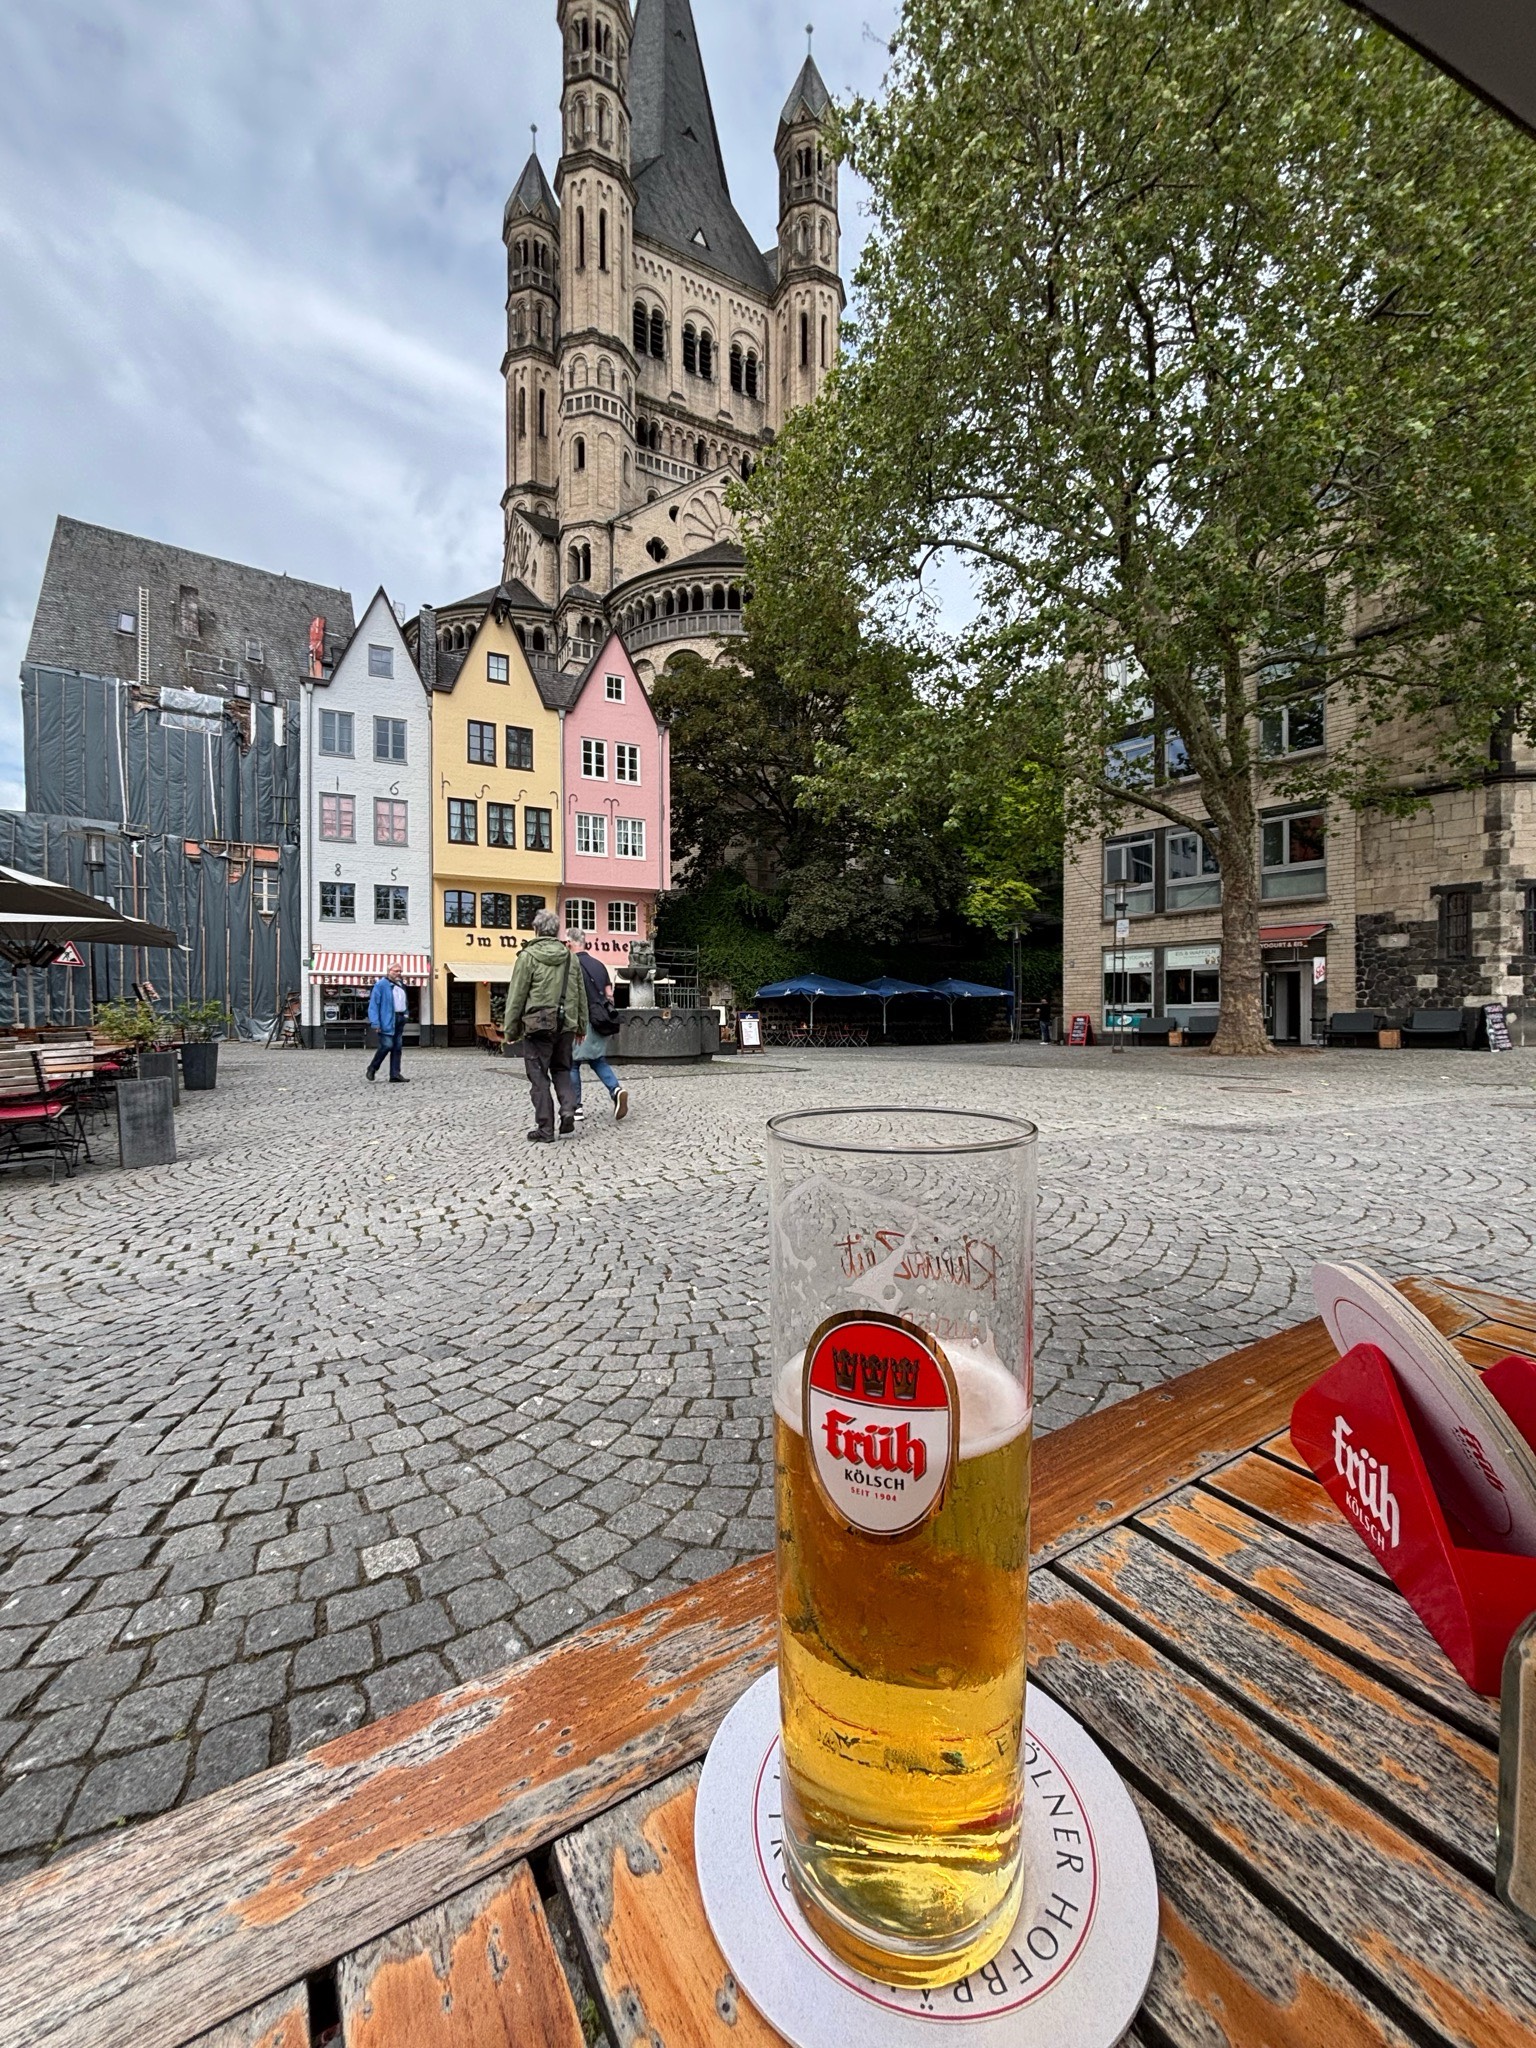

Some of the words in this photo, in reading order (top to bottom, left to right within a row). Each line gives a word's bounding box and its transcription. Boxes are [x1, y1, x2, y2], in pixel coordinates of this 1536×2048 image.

[334, 863, 342, 877] 8
[390, 867, 399, 881] 5
[465, 933, 492, 948] Im
[844, 1468, 905, 1491] KÖLSCH
[850, 1486, 870, 1498] SEIT
[874, 1492, 897, 1502] 1904
[1345, 1490, 1386, 1551] KÖLSCH
